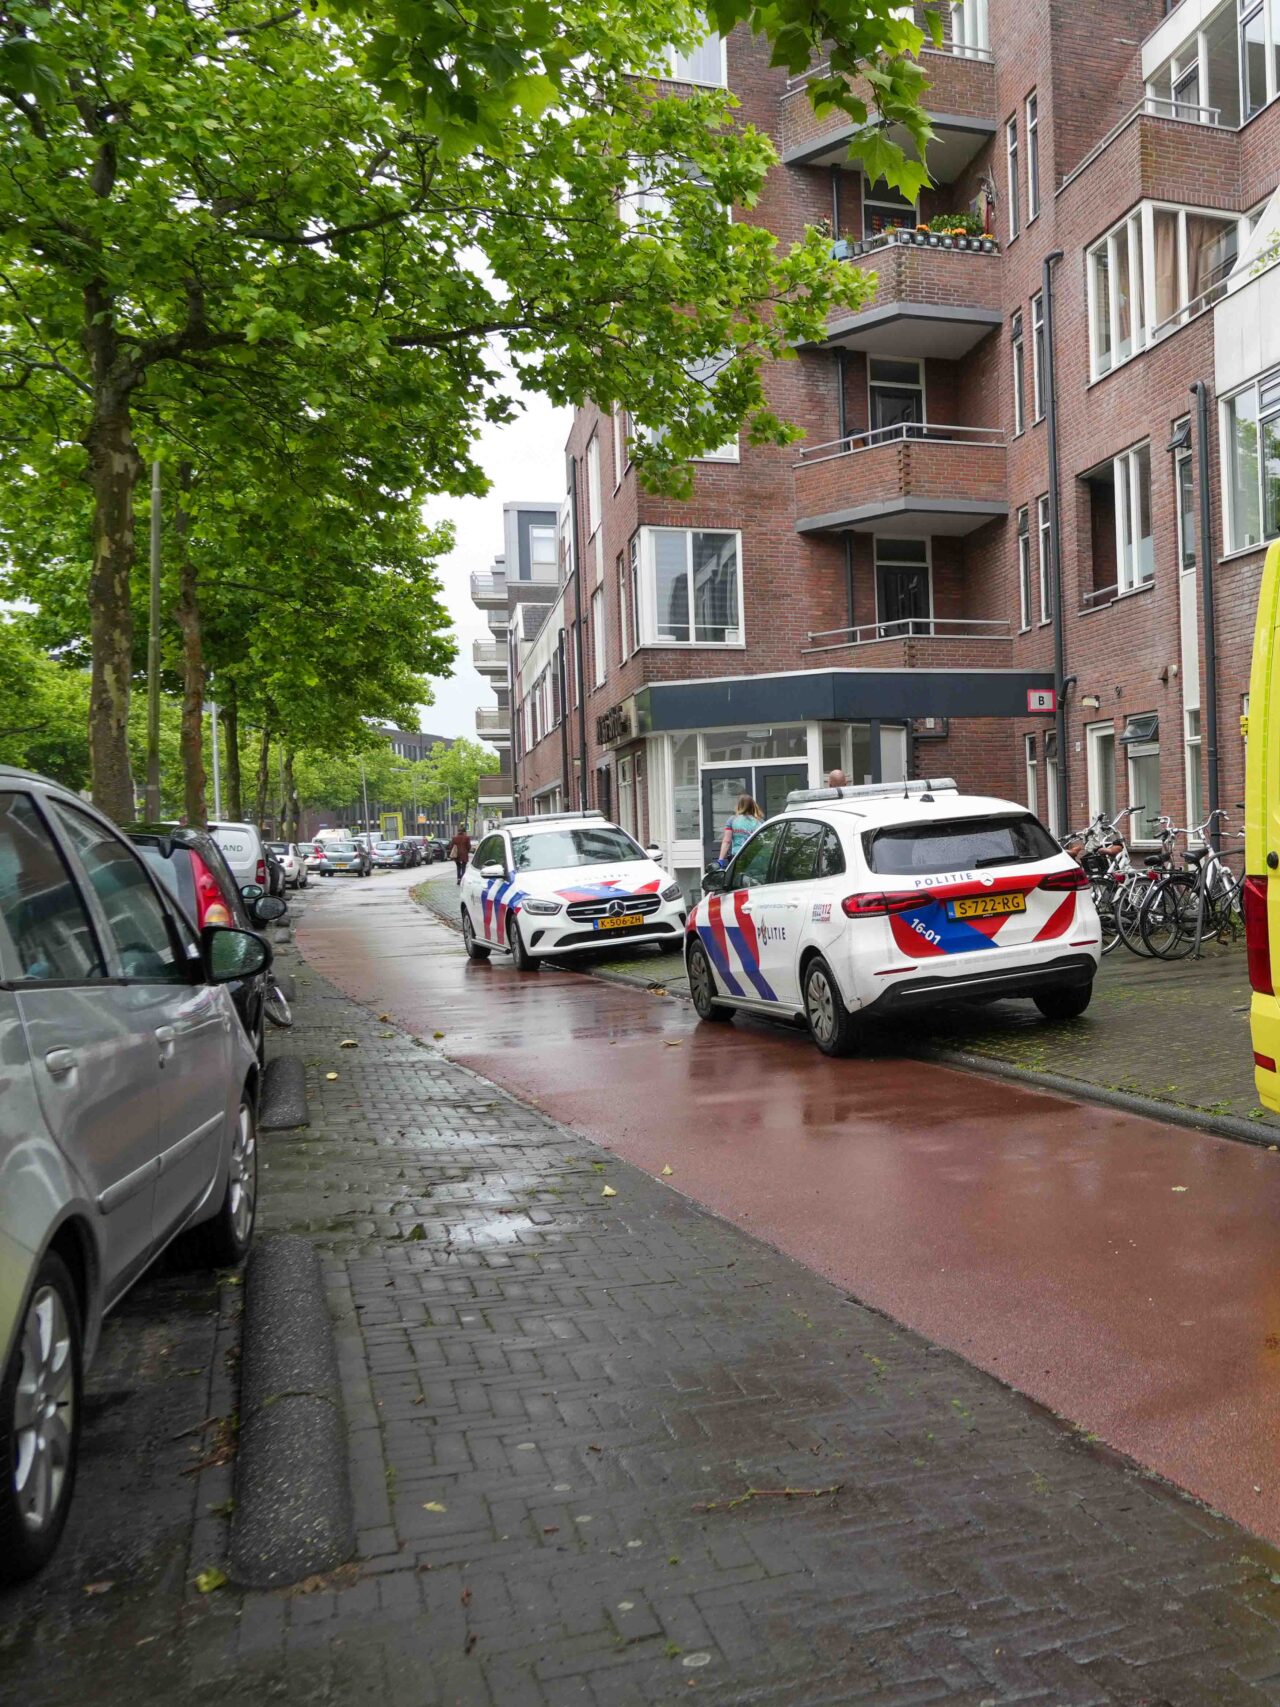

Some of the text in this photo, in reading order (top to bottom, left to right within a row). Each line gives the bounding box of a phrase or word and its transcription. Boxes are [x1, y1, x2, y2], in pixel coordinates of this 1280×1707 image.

[1038, 695, 1045, 706] B
[221, 844, 244, 852] AND
[914, 872, 974, 888] POLITIE
[821, 903, 832, 915] 112
[959, 895, 1020, 915] S-722-RG
[600, 915, 641, 928] K-506-ZH
[910, 918, 942, 945] 16-01
